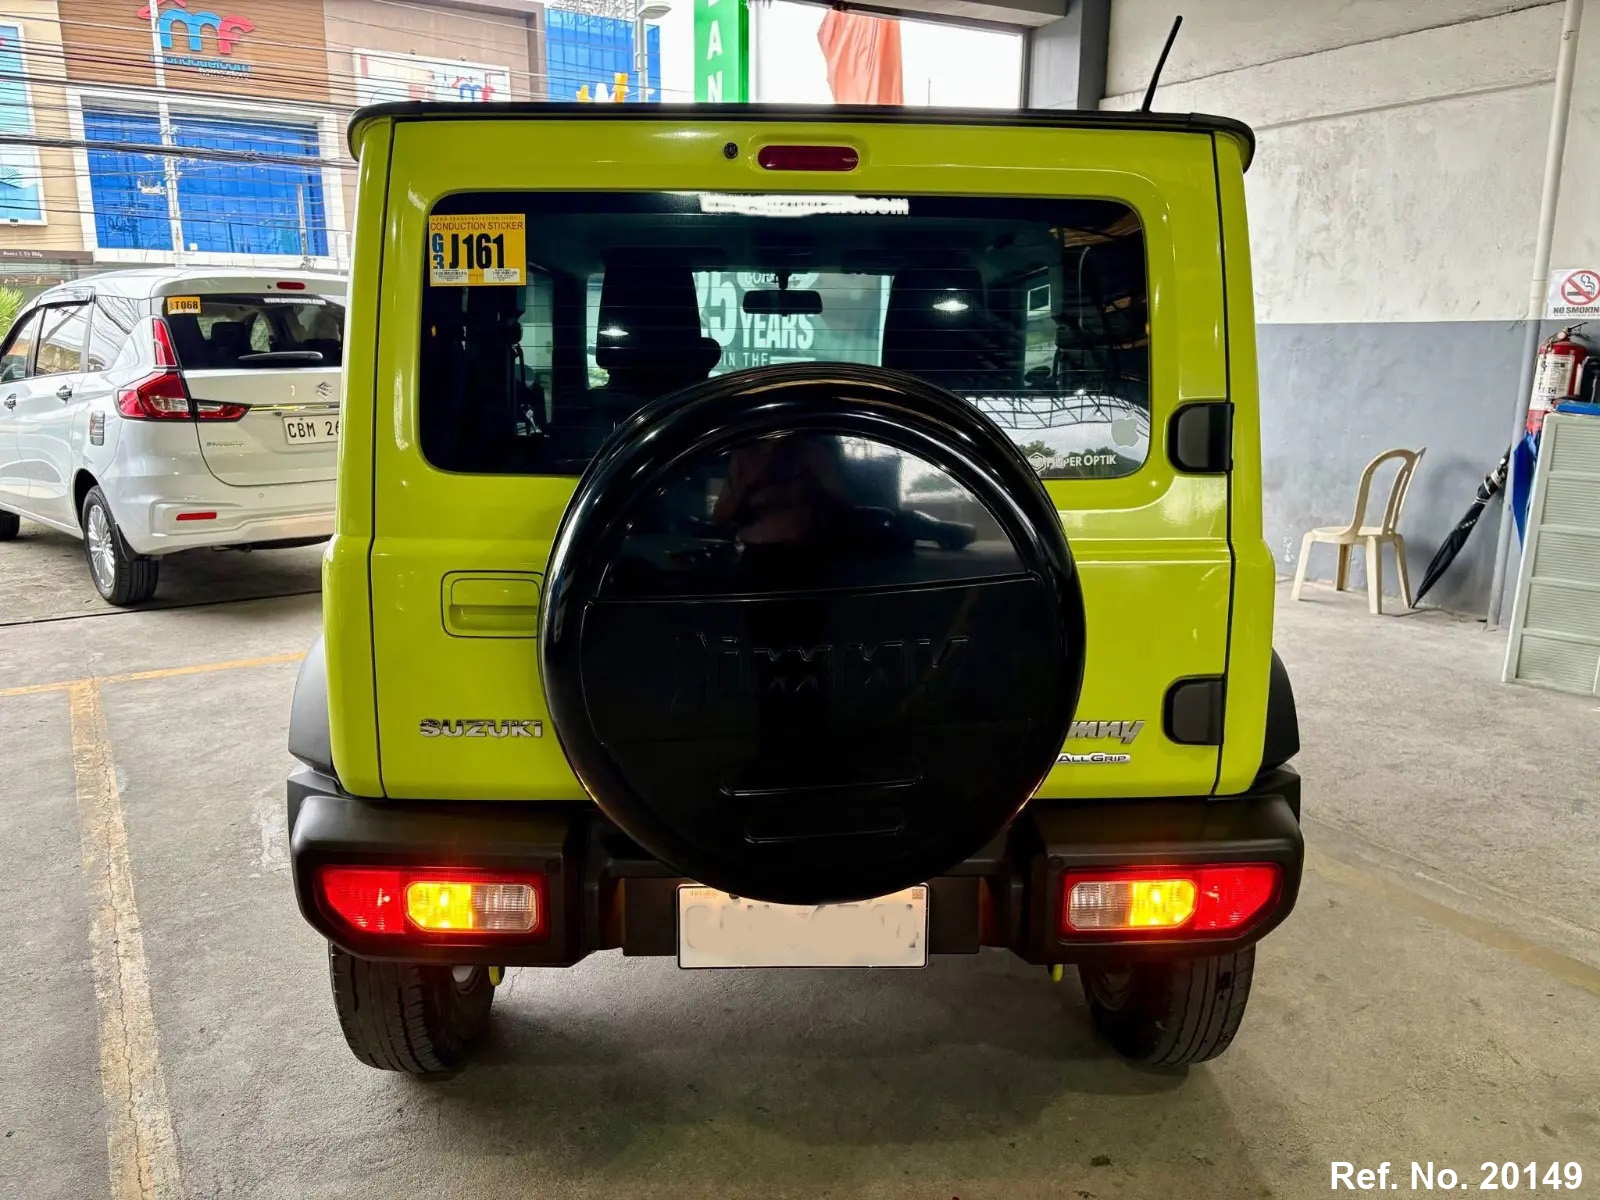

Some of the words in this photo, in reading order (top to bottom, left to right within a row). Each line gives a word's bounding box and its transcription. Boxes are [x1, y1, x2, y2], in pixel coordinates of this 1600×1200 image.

[430, 222, 486, 231] CONDUCTION
[487, 221, 524, 230] STICKER
[448, 232, 505, 270] J161
[1553, 306, 1565, 314] NO
[740, 306, 815, 350] YEARS
[722, 351, 736, 367] IN
[742, 352, 769, 367] THE
[287, 421, 316, 438] CBM
[1083, 454, 1117, 466] OPTIK
[419, 718, 543, 738] SUZUKI
